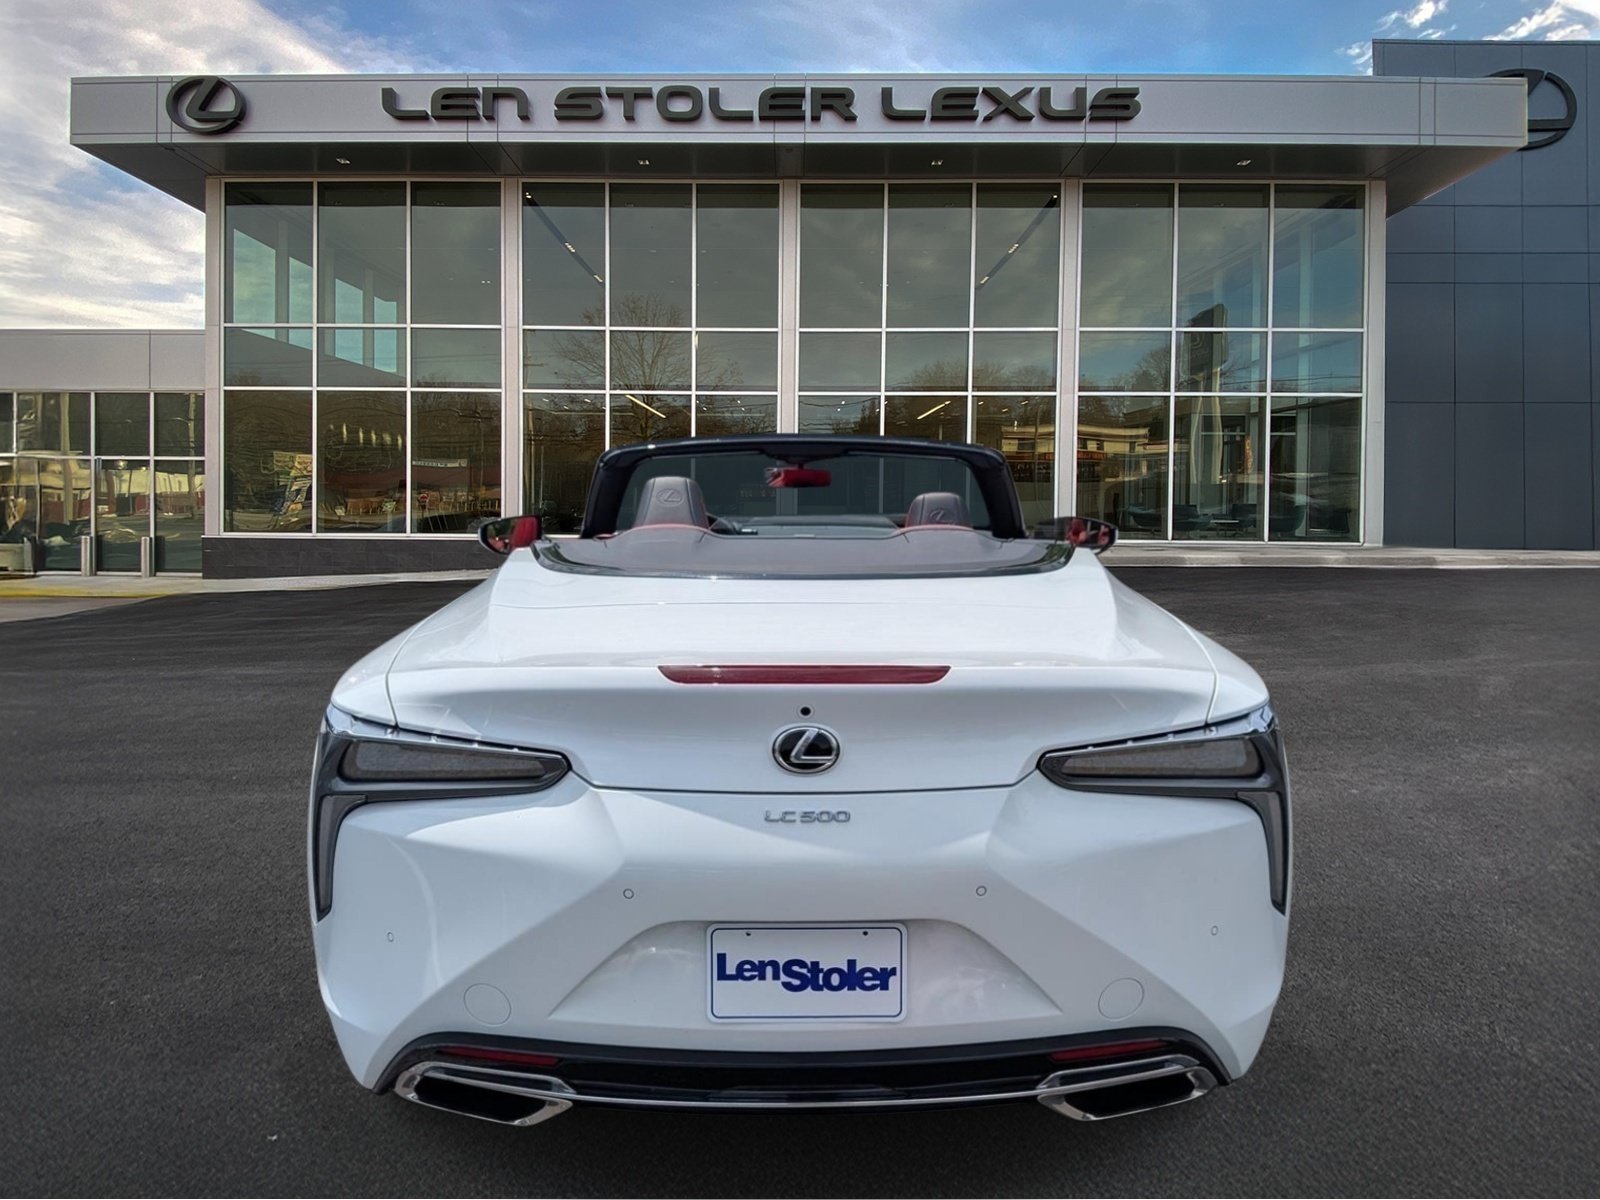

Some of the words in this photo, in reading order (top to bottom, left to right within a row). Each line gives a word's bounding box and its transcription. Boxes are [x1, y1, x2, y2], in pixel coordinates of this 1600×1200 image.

[381, 86, 530, 121] LEN
[554, 85, 857, 122] STOLER
[881, 86, 1142, 122] LEXUS
[764, 810, 797, 824] LC
[800, 811, 851, 824] 500
